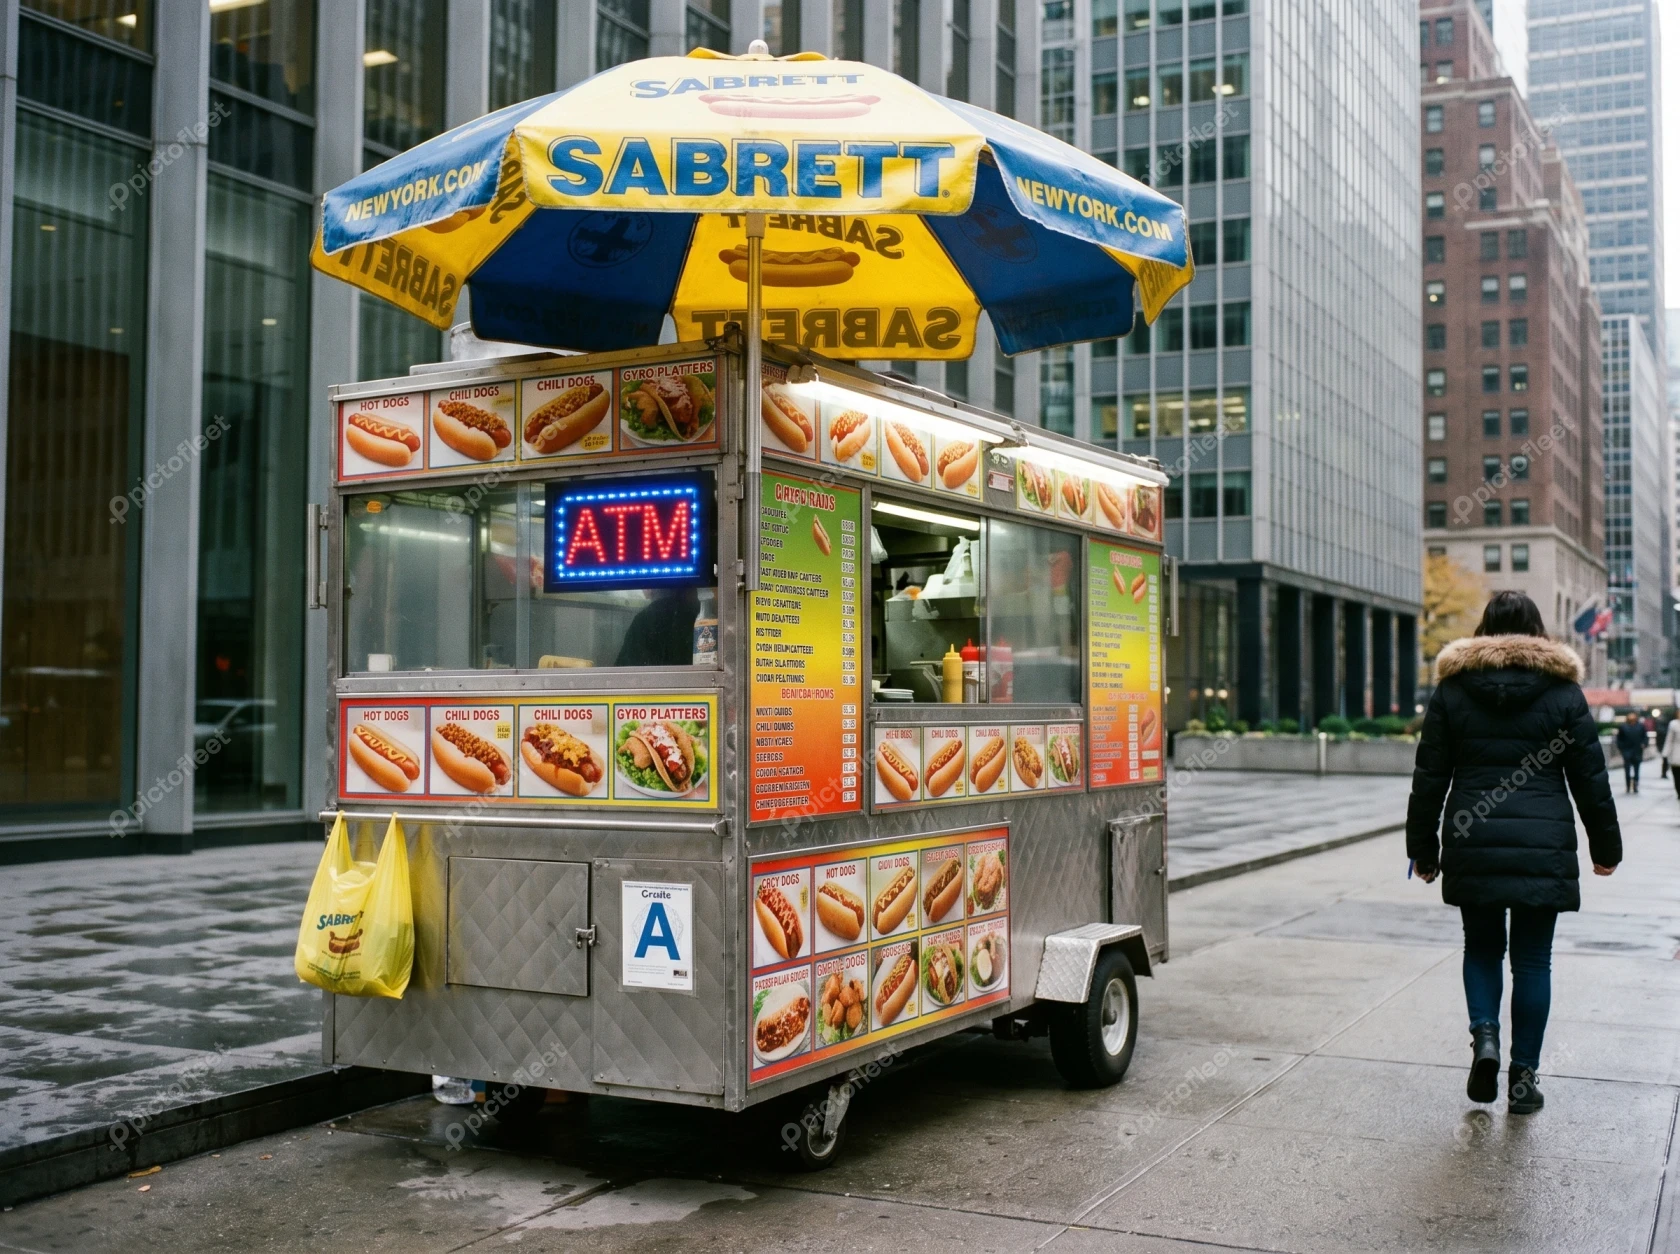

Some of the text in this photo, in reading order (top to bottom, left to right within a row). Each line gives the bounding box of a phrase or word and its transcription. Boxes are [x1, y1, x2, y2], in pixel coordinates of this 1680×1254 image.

[629, 73, 865, 98] SABRETT
[1016, 176, 1173, 242] NEWYORK.COM
[623, 361, 714, 382] GYRO PLATTERS
[536, 375, 596, 391] CHILI DOGS
[449, 385, 501, 402] CHILI DOGS
[360, 396, 410, 412] HOT DOGS
[565, 501, 688, 566] ATM
[363, 710, 409, 721] HOT DOGS
[445, 709, 500, 721] CHILI DOGS
[534, 708, 593, 721] CHILI DOGS
[617, 707, 707, 720] GYRO PLATTERS
[781, 873, 800, 887] DOGS
[826, 867, 838, 879] HOT
[634, 902, 681, 960] A
